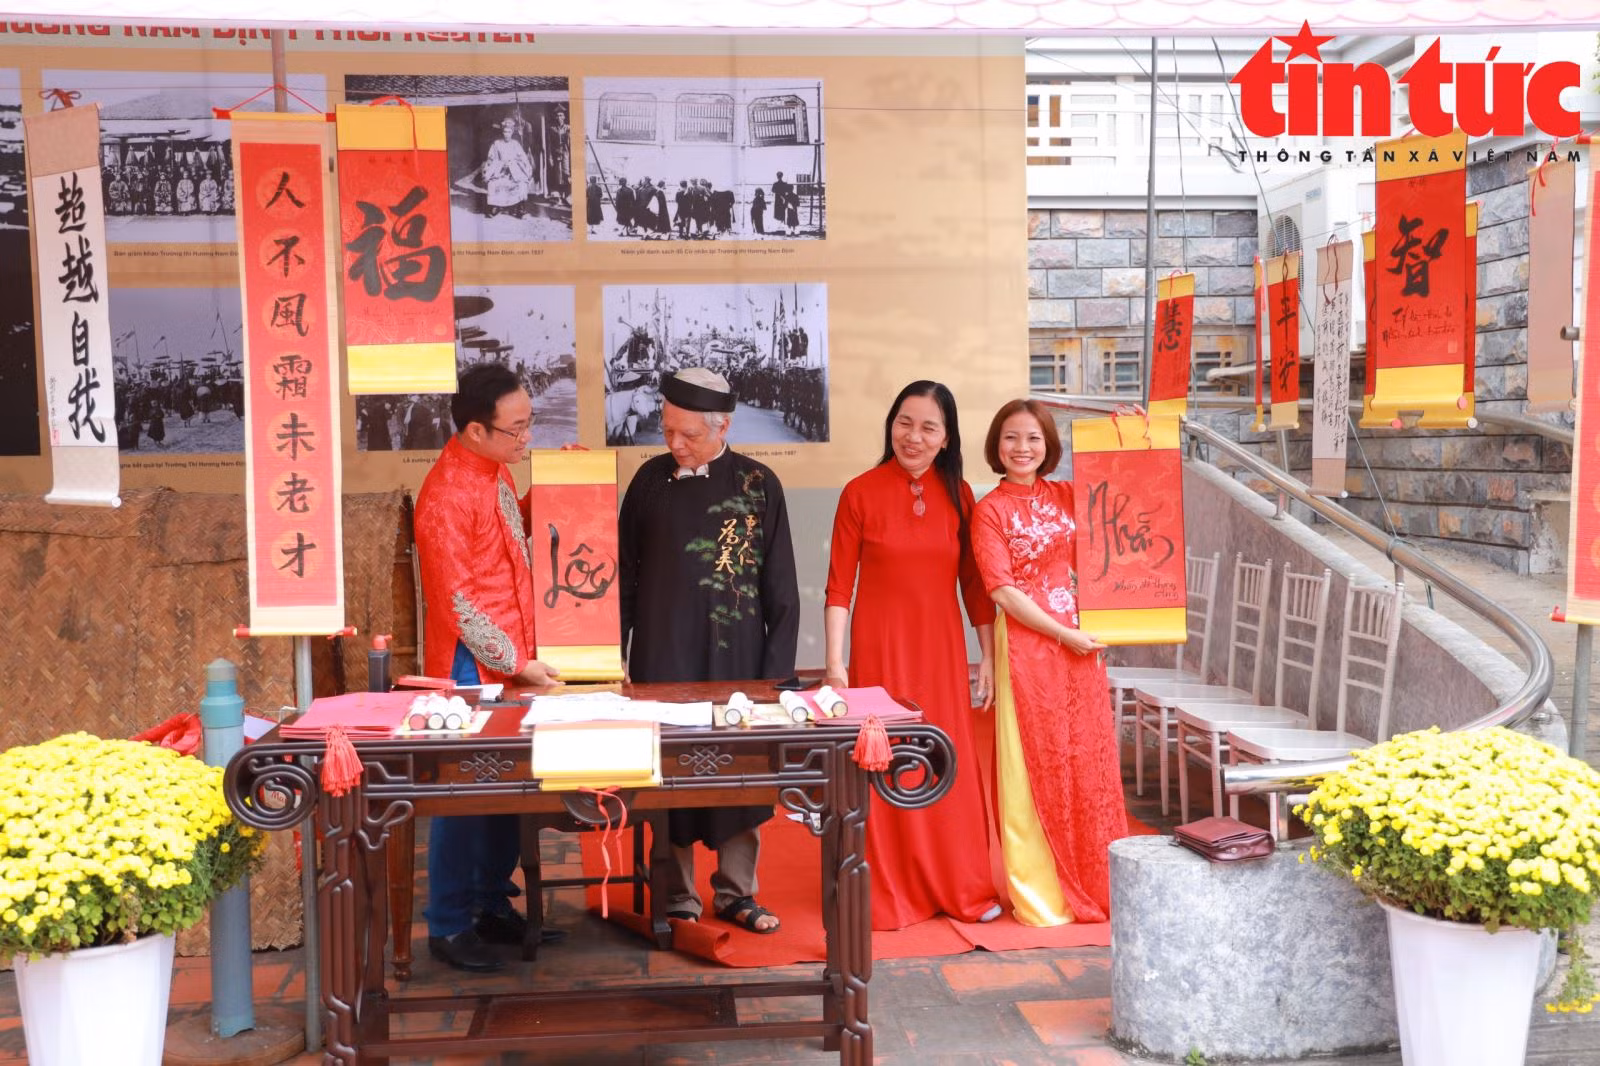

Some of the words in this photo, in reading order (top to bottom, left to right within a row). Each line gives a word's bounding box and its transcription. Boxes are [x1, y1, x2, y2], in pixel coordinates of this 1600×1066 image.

[345, 185, 447, 303] 福
[1386, 213, 1449, 297] 智
[54, 171, 106, 443] 超越自我
[265, 171, 317, 579] 人不風霜未老才
[543, 523, 618, 608] Lộc
